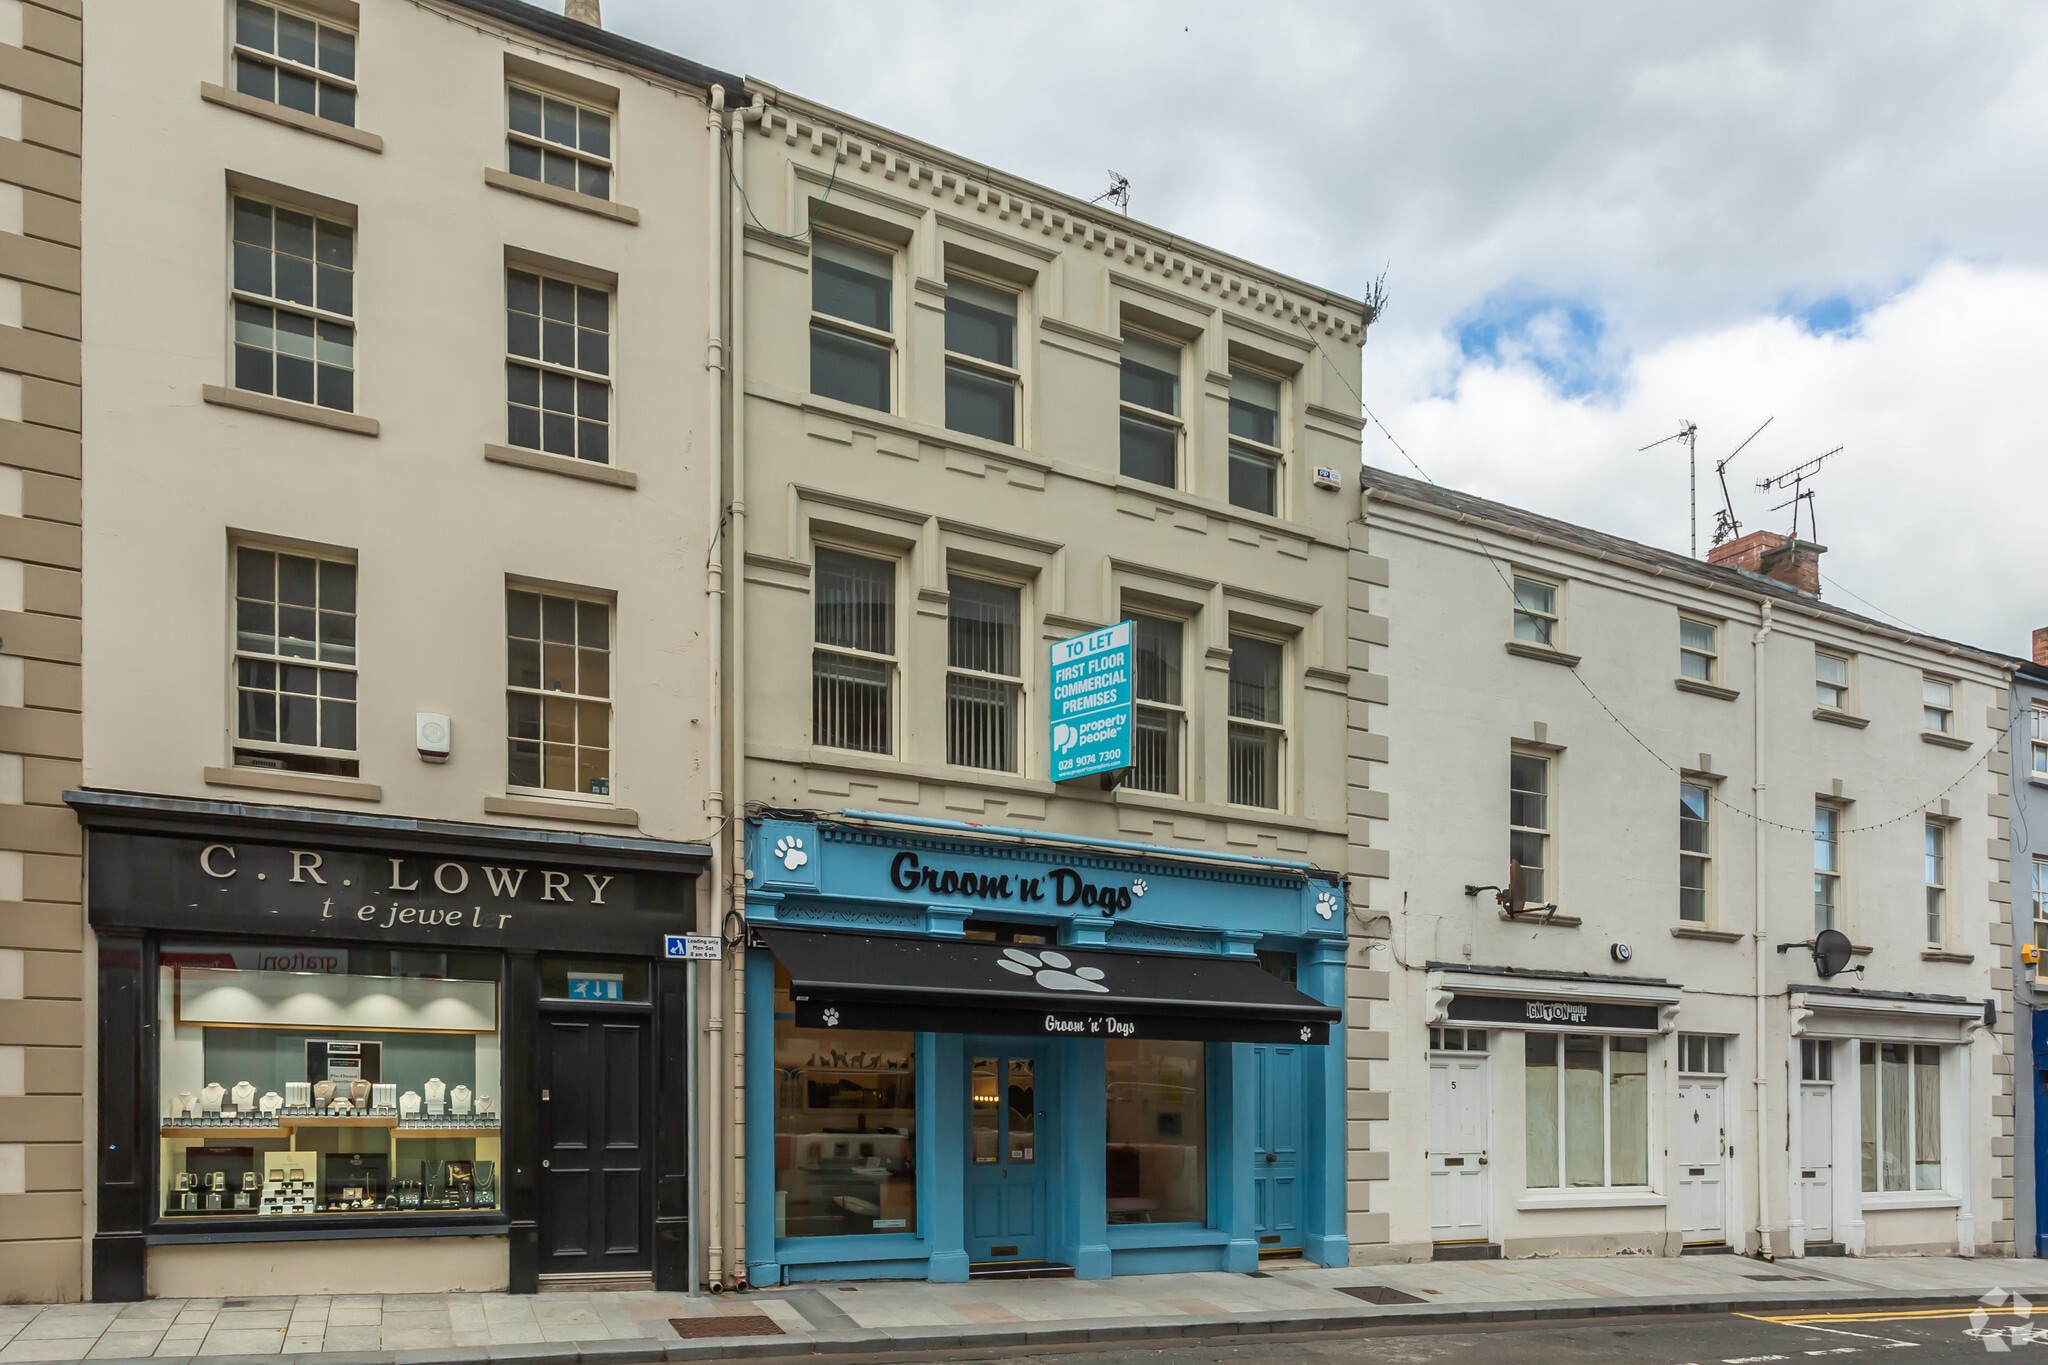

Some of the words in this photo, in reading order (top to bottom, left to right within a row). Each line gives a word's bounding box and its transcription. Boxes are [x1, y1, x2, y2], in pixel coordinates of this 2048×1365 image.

[1066, 641, 1084, 658] TO
[1089, 631, 1113, 651] LET
[1056, 662, 1085, 683] FIRST
[1088, 652, 1125, 674] FLOOR
[1054, 669, 1127, 700] COMMERCIAL
[1062, 688, 1117, 715] PREMISES
[1080, 713, 1127, 735] property
[1080, 727, 1117, 746] people
[1058, 759, 1073, 771] 028
[1076, 753, 1096, 767] 9074
[1098, 748, 1121, 762] 7300
[388, 858, 615, 905] LOWRY
[890, 851, 1014, 900] Groom
[1049, 867, 1133, 918] Dogs
[1526, 1001, 1569, 1021] IGNITION
[1571, 1013, 1586, 1022] art
[1045, 1014, 1085, 1033] Groom
[1105, 1016, 1135, 1037] Dogs
[1451, 1081, 1457, 1090] 5
[1002, 1169, 1008, 1179] 3
